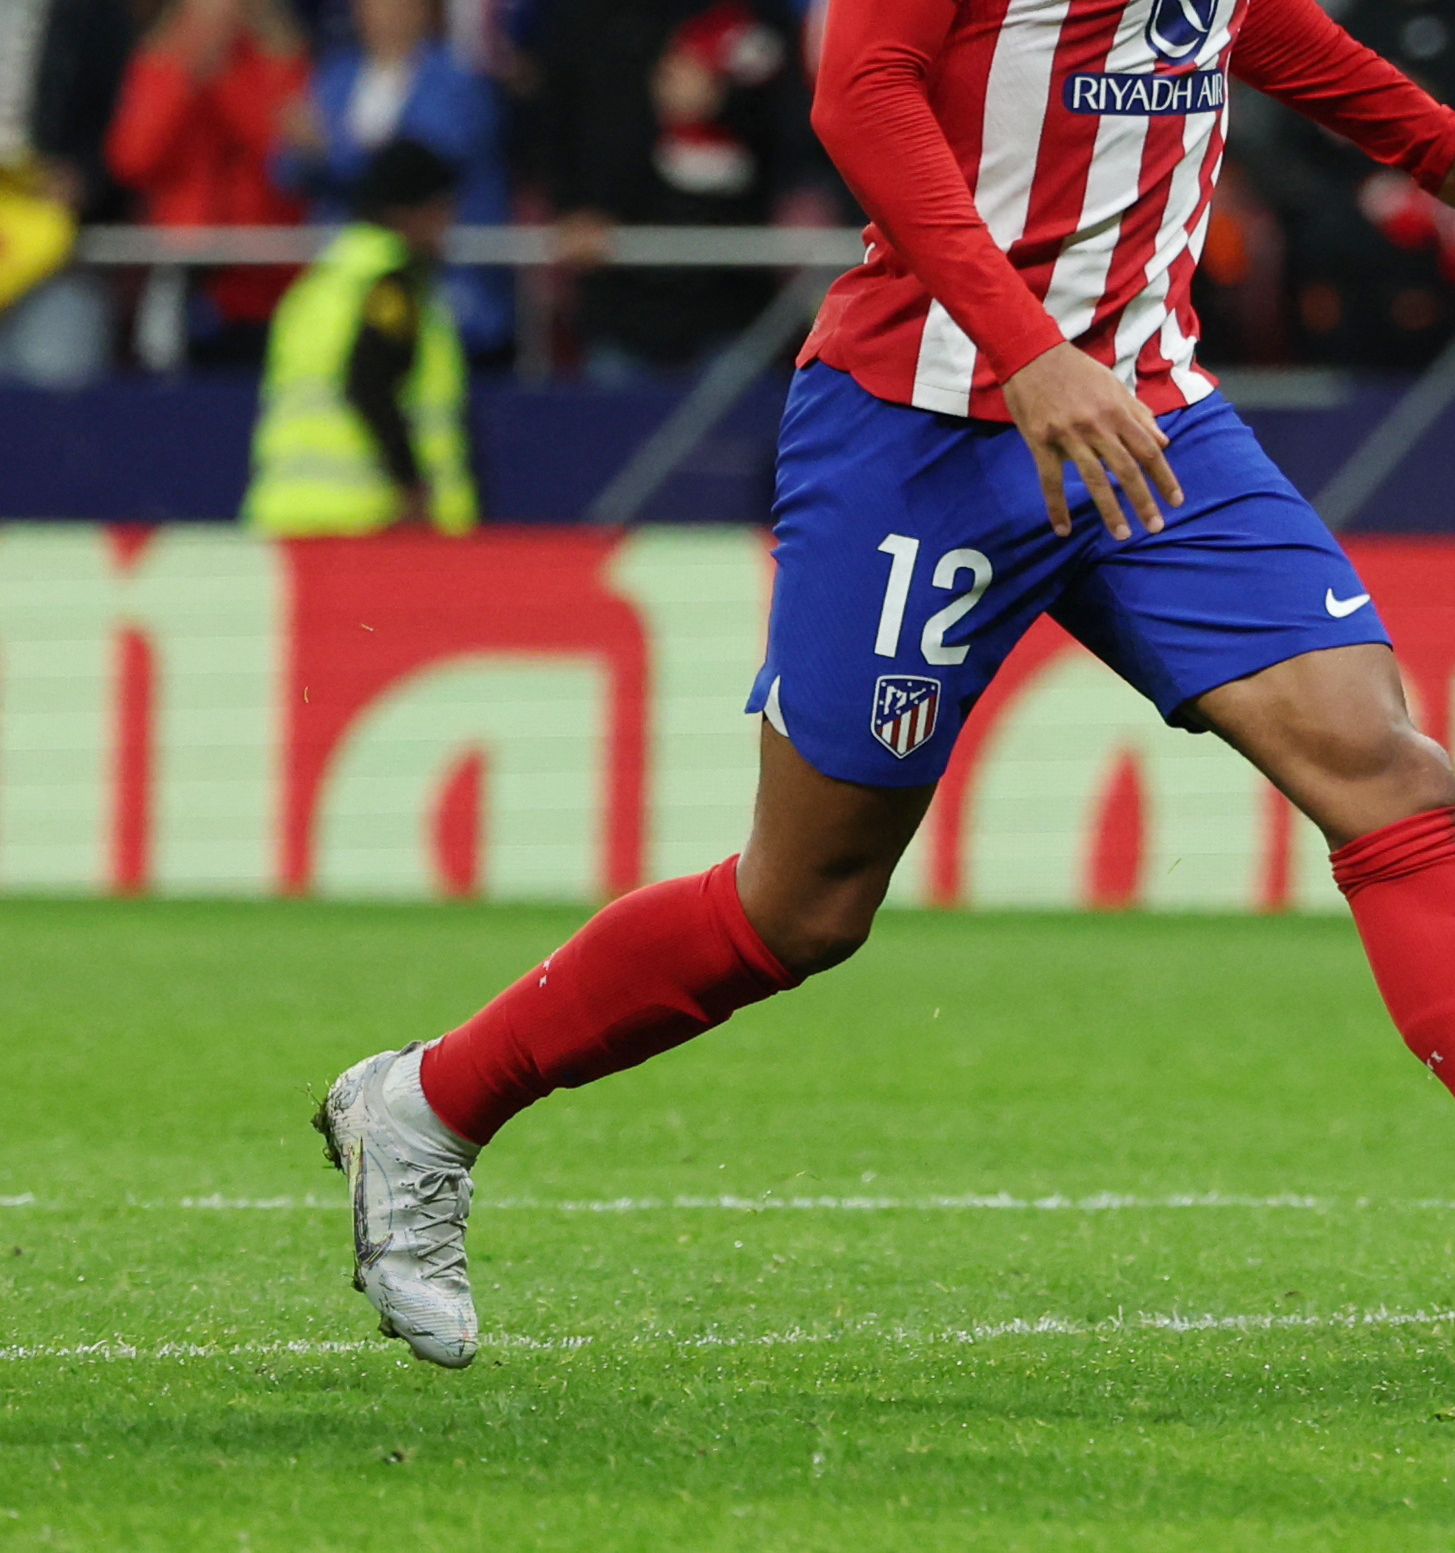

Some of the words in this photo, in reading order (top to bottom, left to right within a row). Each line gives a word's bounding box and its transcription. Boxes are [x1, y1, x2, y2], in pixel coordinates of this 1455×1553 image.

[1072, 76, 1193, 112] RIYADH
[1197, 73, 1224, 109] AIR
[874, 533, 993, 666] 12
